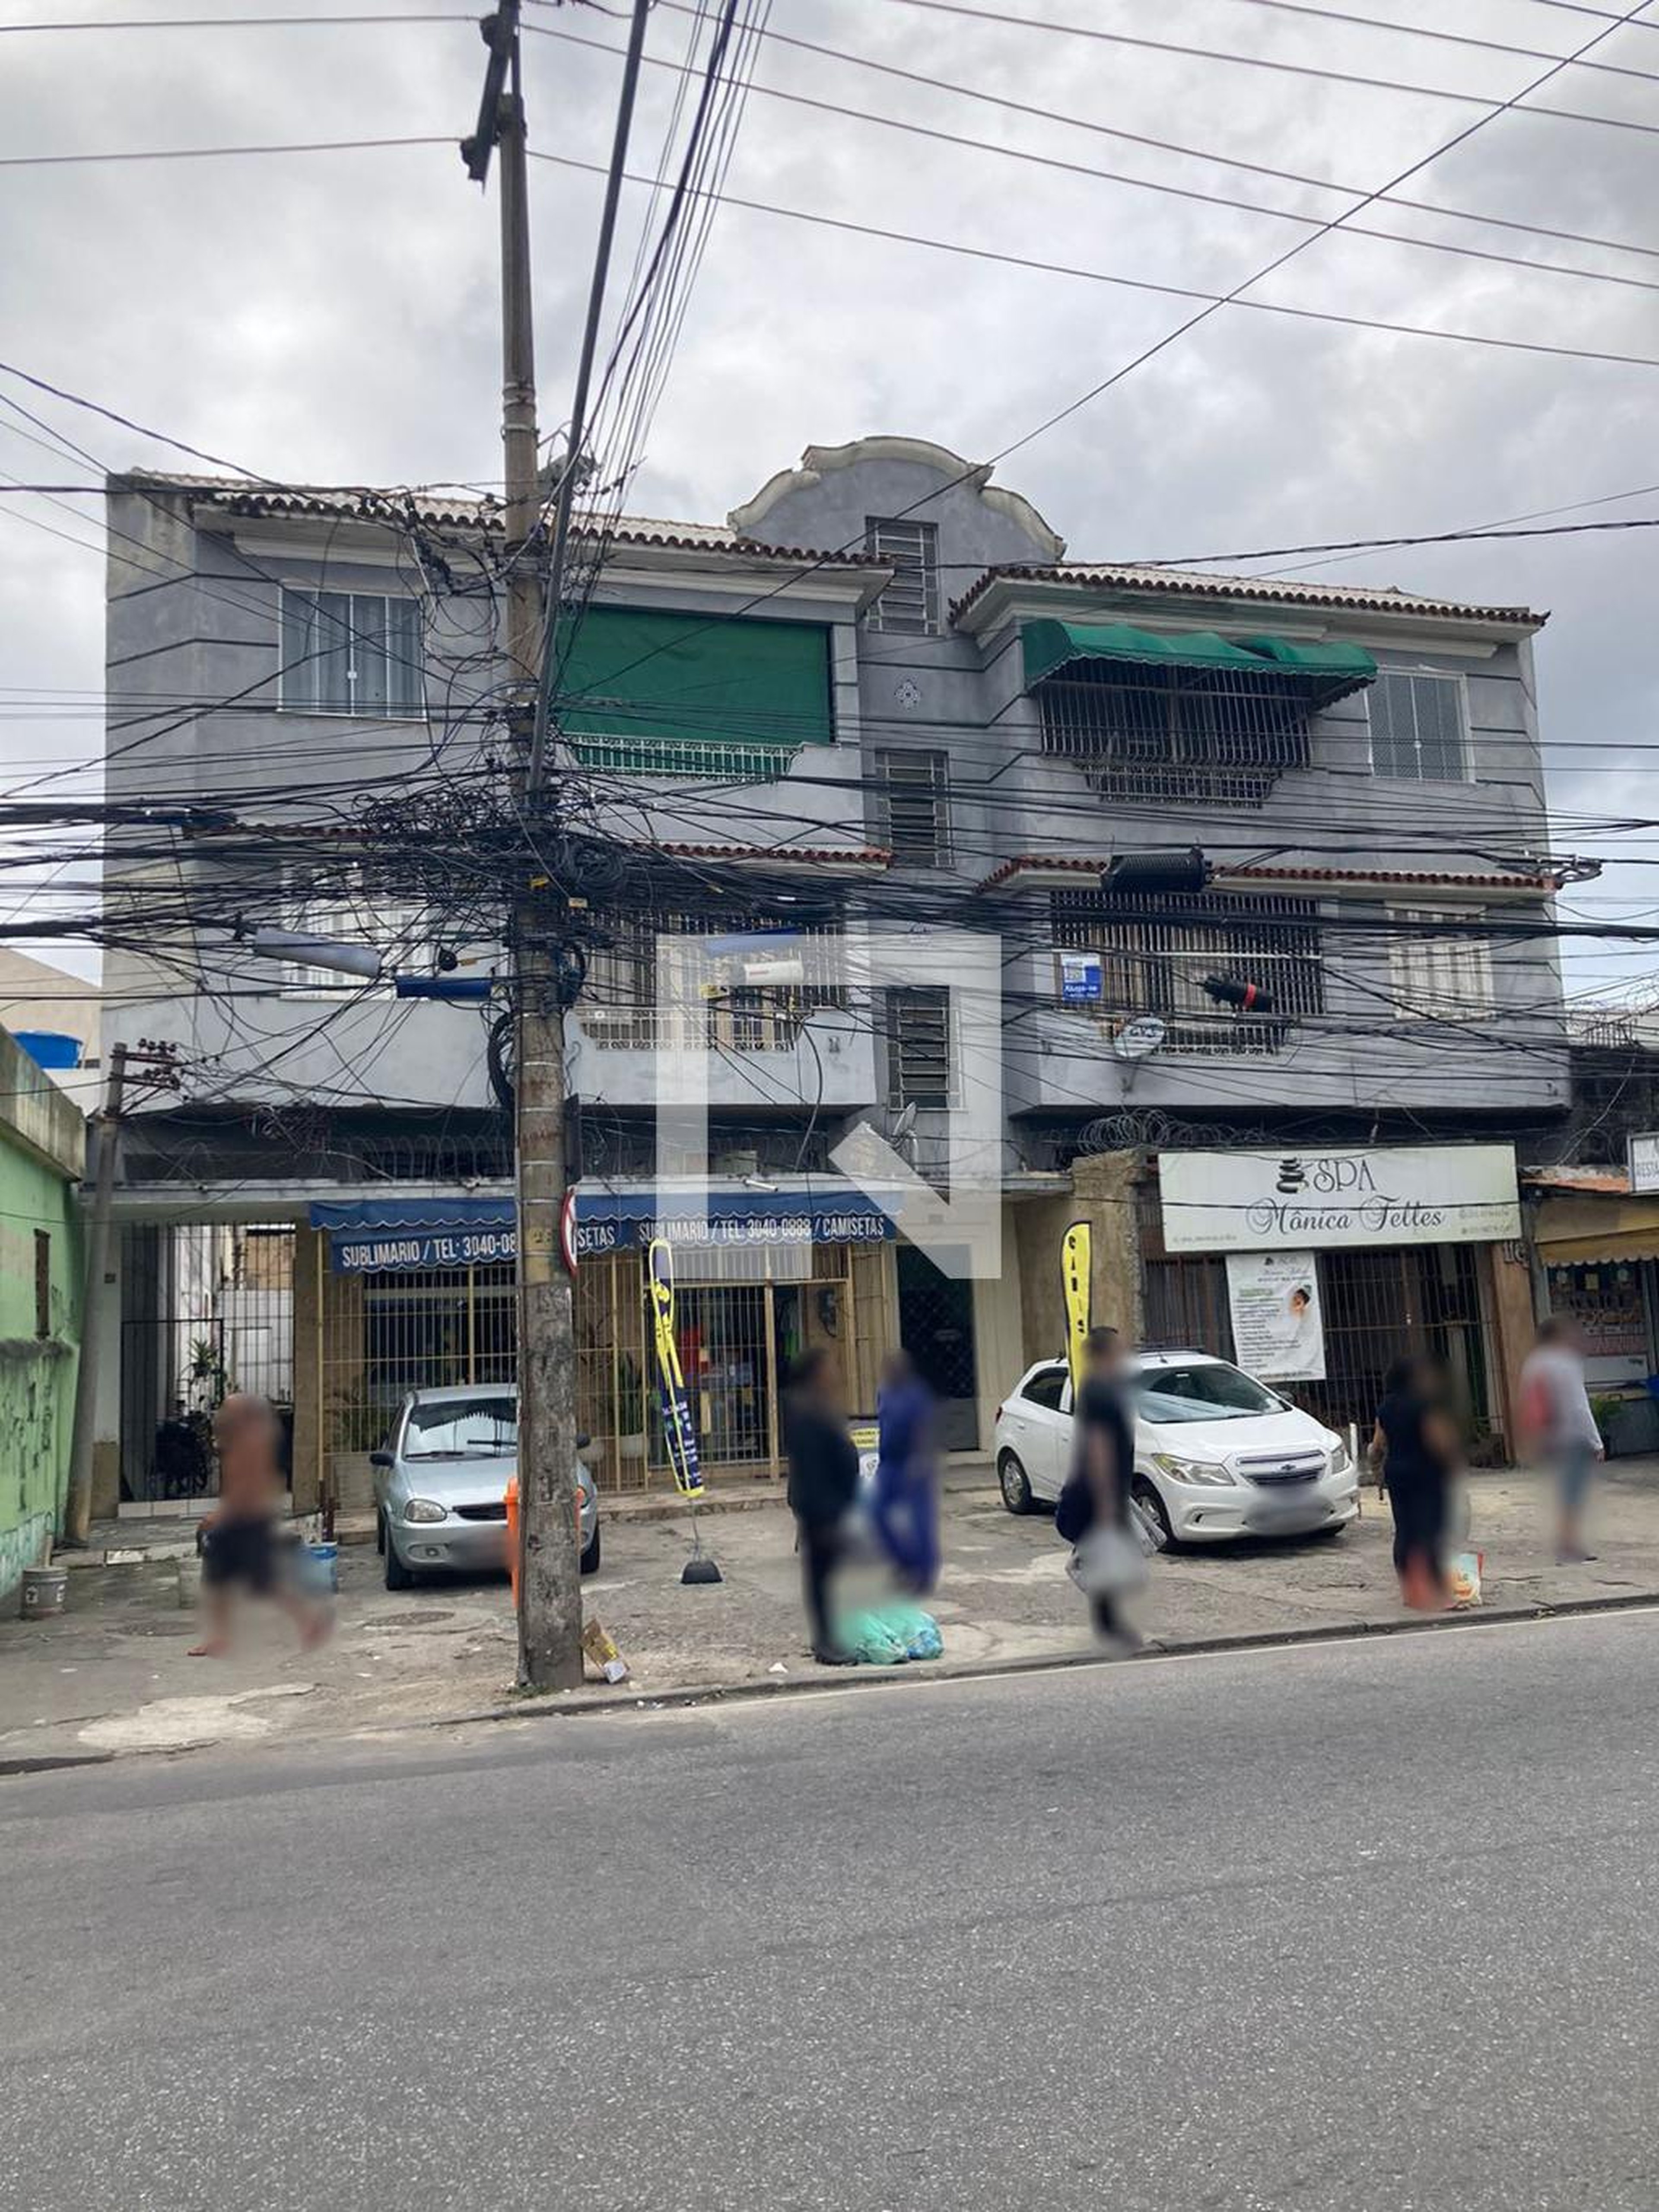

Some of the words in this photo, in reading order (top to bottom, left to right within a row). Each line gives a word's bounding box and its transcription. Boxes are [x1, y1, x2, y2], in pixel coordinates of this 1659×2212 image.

[1314, 1159, 1377, 1193] SPA
[639, 1220, 708, 1242] SUBLIMARIO
[747, 1218, 811, 1238] 3040-0888
[823, 1217, 884, 1237] CAMISETAS
[1360, 1195, 1445, 1232] Telles
[342, 1241, 420, 1267] SUBLIMARIO
[463, 1233, 516, 1257] 3040-08
[578, 1226, 616, 1248] SETAS
